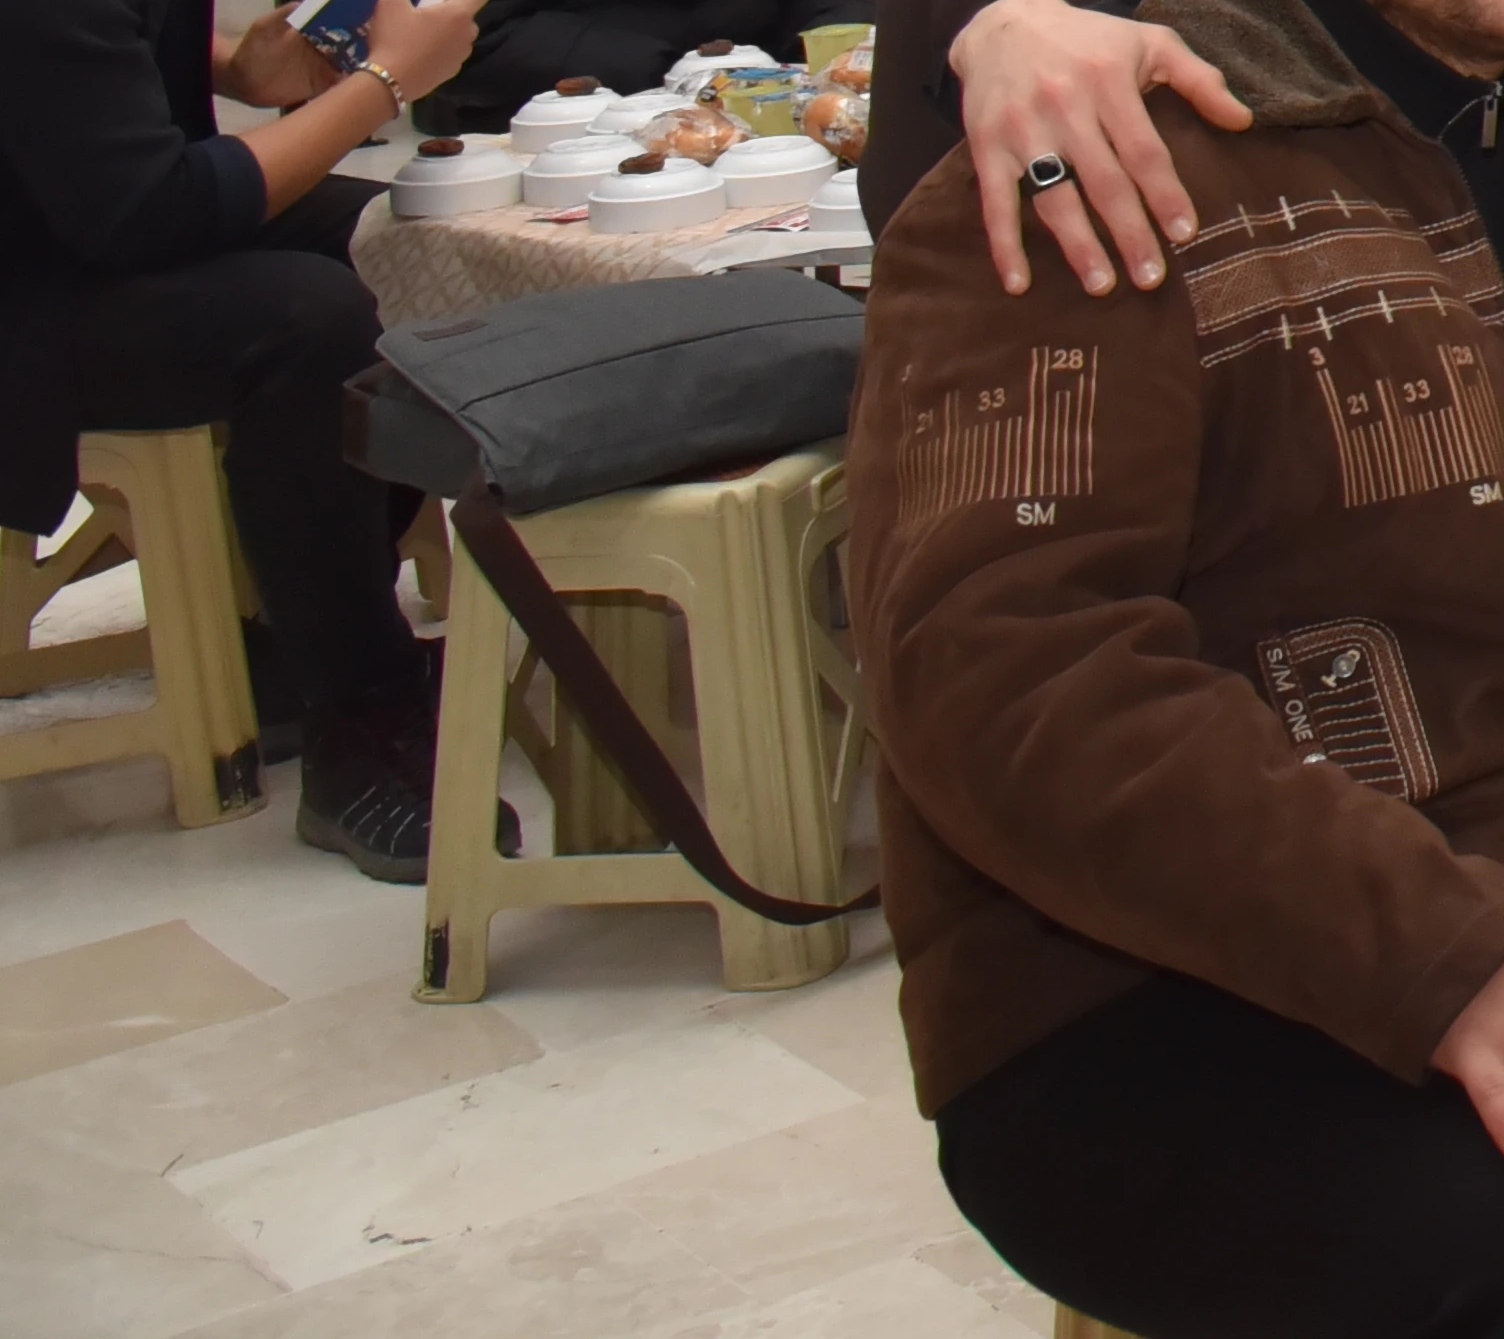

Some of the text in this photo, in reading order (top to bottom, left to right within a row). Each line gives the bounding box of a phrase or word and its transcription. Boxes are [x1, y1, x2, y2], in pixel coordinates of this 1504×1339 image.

[1050, 348, 1085, 370] 28
[1308, 346, 1326, 366] 3
[1452, 345, 1474, 365] 28
[977, 387, 1006, 412] 33
[1403, 378, 1431, 403] 33
[1347, 391, 1370, 416] 21
[1469, 480, 1504, 506] SM
[1016, 501, 1056, 526] SM
[1266, 647, 1314, 743] S/M ONE
